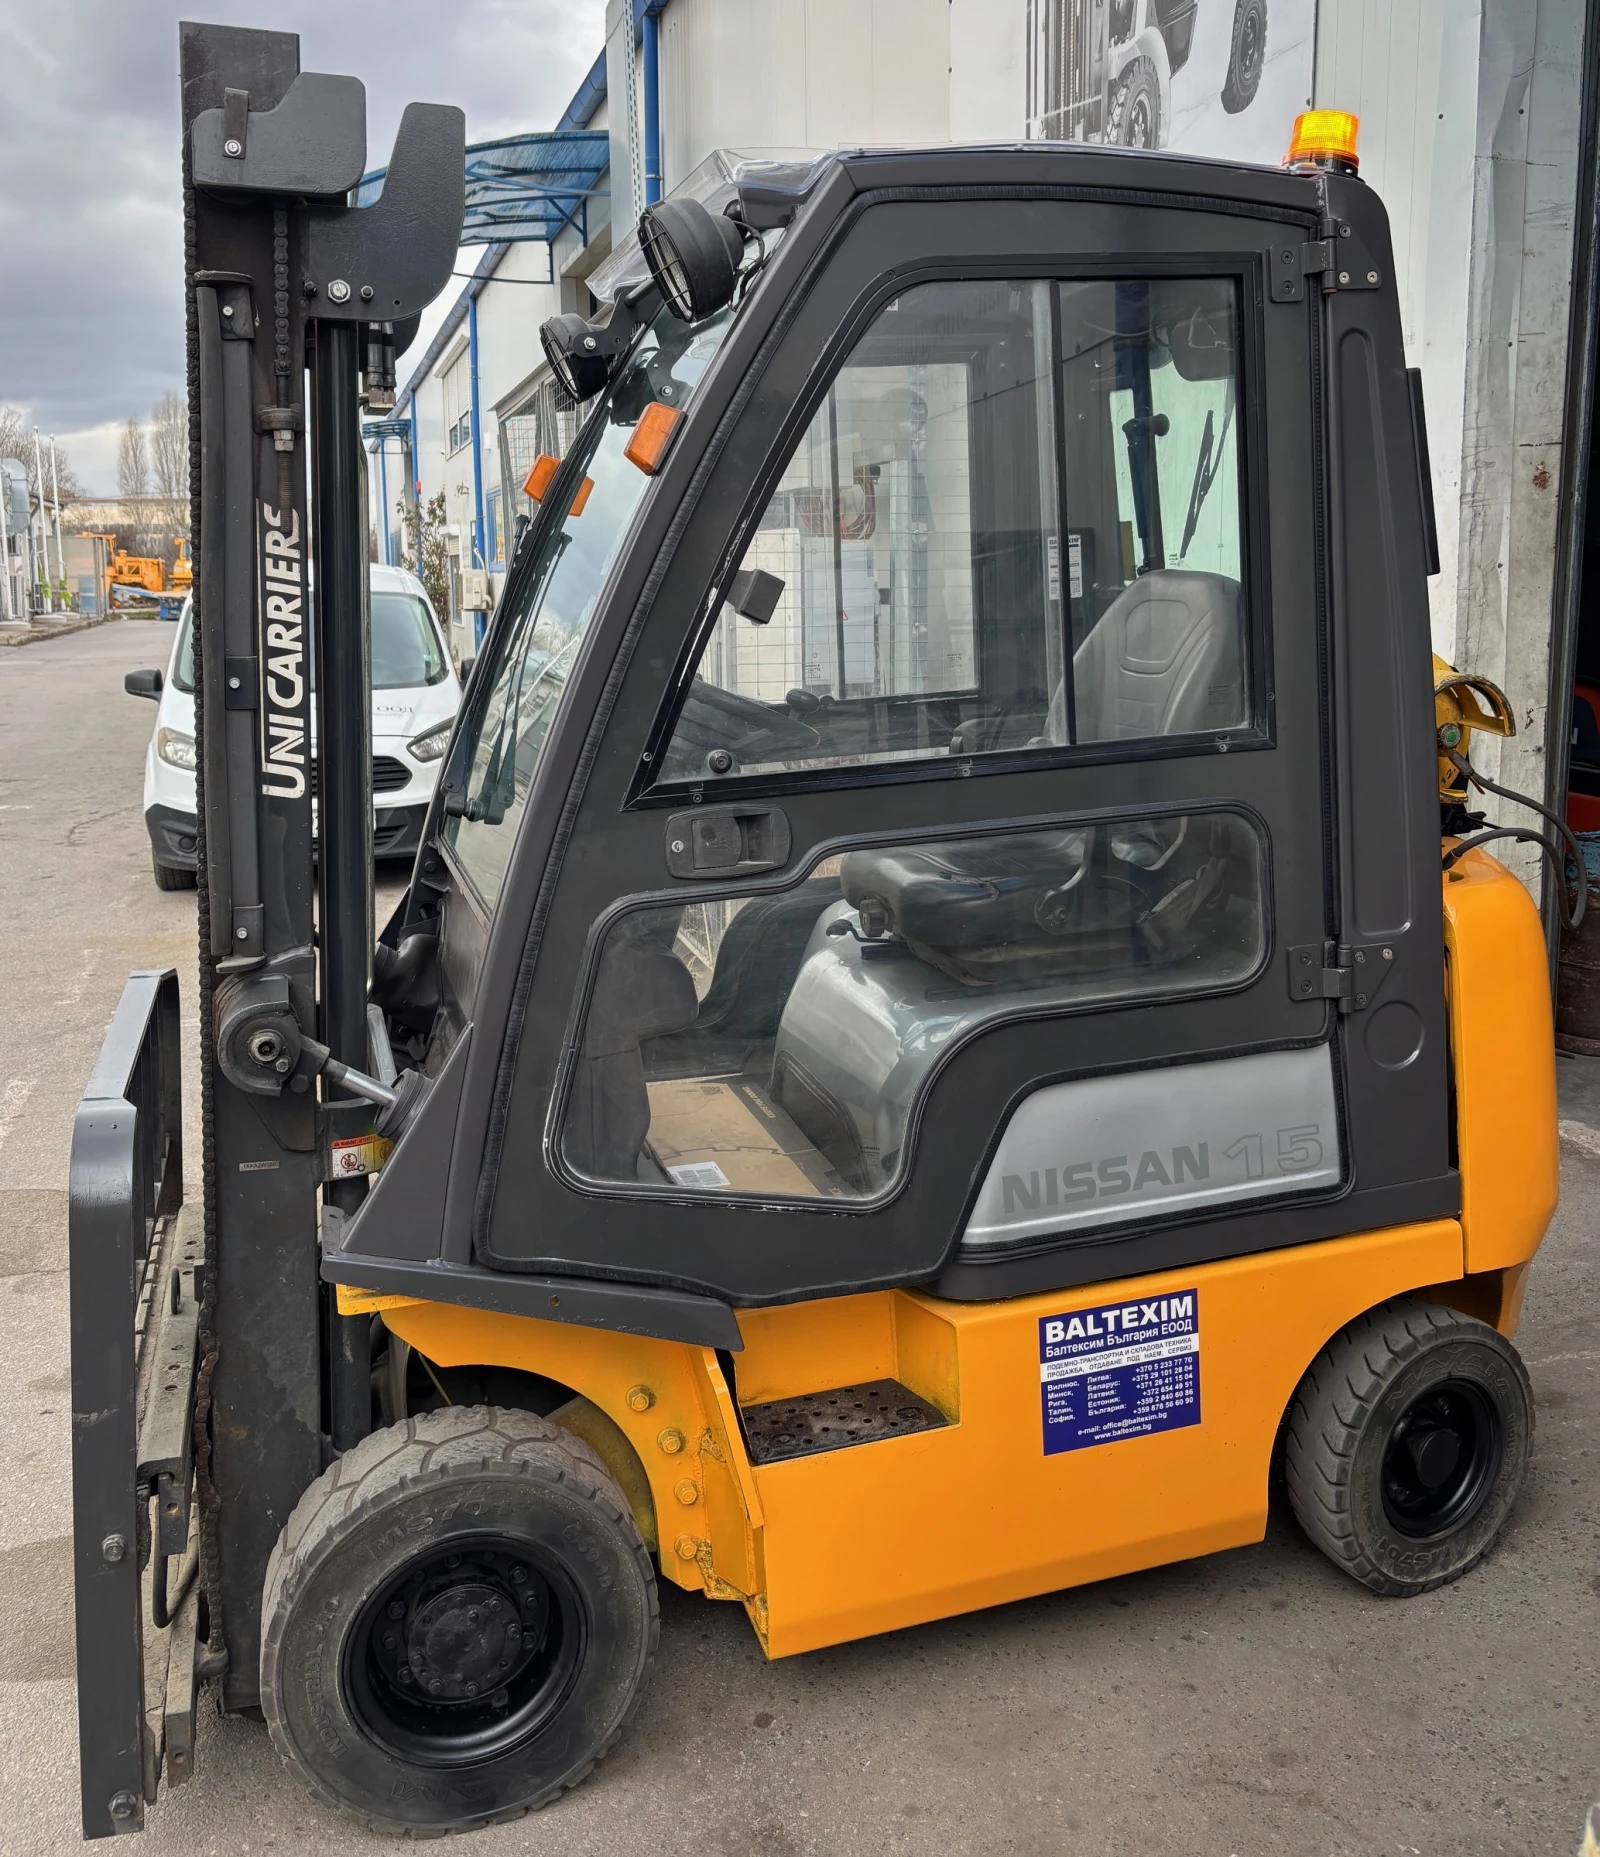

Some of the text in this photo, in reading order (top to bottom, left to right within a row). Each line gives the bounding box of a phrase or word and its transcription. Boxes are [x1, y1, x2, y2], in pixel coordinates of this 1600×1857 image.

[262, 502, 305, 799] UNICARRIERS
[1002, 1124, 1323, 1214] NISSAN 15
[1046, 1296, 1193, 1344] BALTEXIM
[1046, 1319, 1193, 1358] Балтексим България ЕООД
[1047, 1351, 1124, 1371] ПОДЕМНО-ТРАНСПОРТНА
[1131, 1343, 1164, 1355] СКЛАДОВА
[1165, 1337, 1192, 1348] ТЕХНИКА
[1089, 1358, 1122, 1371] ОТДАВАНЕ
[1168, 1344, 1192, 1355] СЕРВИЗ
[1136, 1365, 1152, 1373] +370
[1160, 1361, 1173, 1369] 233
[1087, 1381, 1121, 1392] Беларус:
[1132, 1374, 1149, 1382] +375
[1160, 1369, 1172, 1377] 101
[1087, 1389, 1117, 1400] Латвия:
[1136, 1380, 1153, 1389] +371
[1088, 1396, 1121, 1408] Естония:
[1142, 1387, 1159, 1396] +372
[1160, 1385, 1173, 1393] 654
[1088, 1404, 1127, 1416] България:
[1136, 1397, 1154, 1406] +359
[1160, 1393, 1173, 1401] 840
[1175, 1390, 1183, 1398] 60
[1132, 1406, 1150, 1414] +359
[1184, 1396, 1194, 1404] 90
[1077, 1412, 1168, 1436] e-mail: office@baltexim.bg
[1094, 1423, 1152, 1440] www.baltexim.bg
